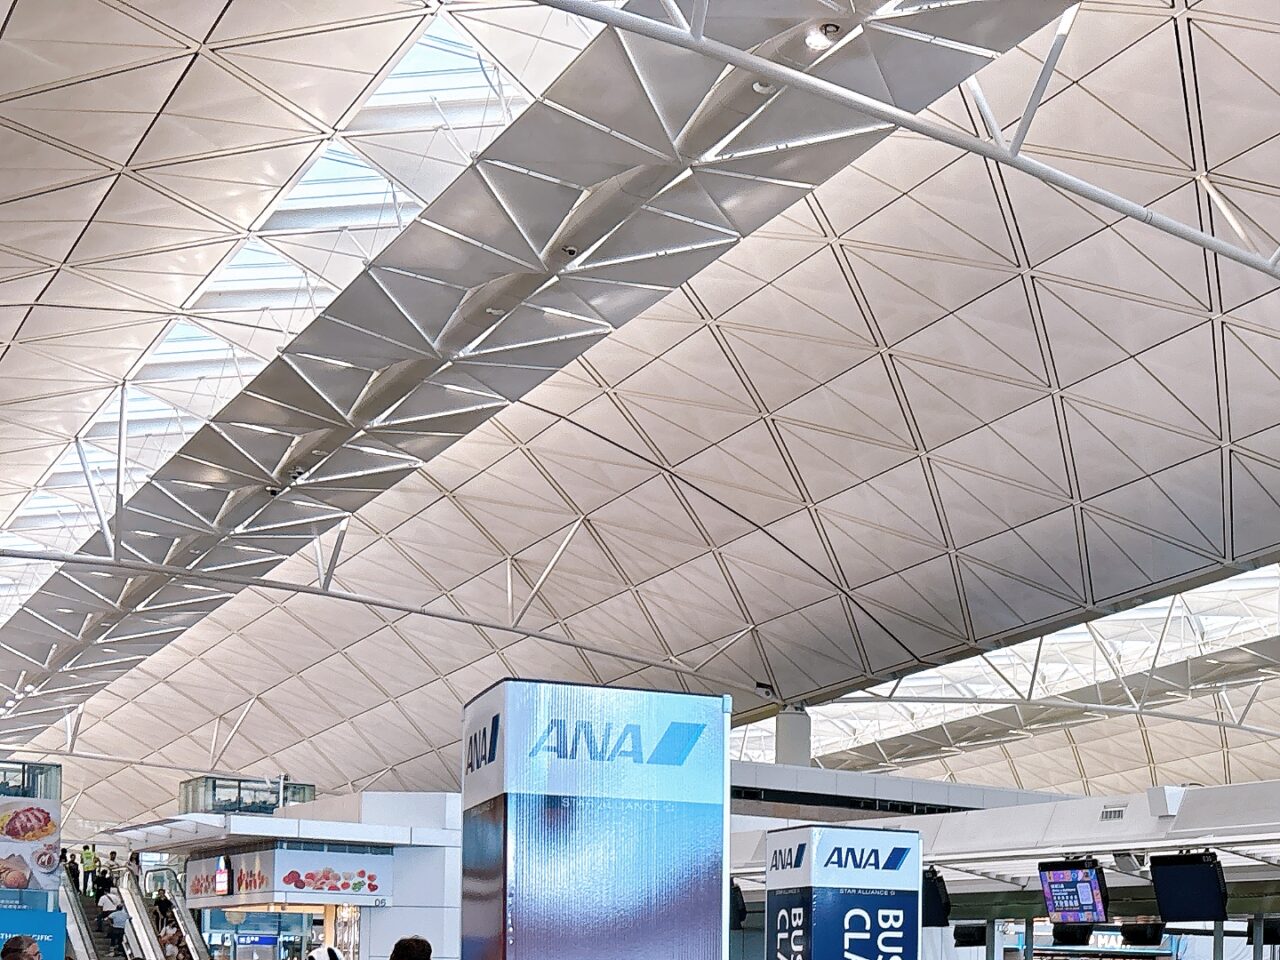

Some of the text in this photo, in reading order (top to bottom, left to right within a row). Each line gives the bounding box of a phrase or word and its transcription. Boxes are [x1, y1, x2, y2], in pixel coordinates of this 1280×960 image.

[466, 727, 487, 775] ANA
[528, 718, 644, 764] ANA
[769, 847, 793, 872] ANA
[824, 847, 881, 871] ANA
